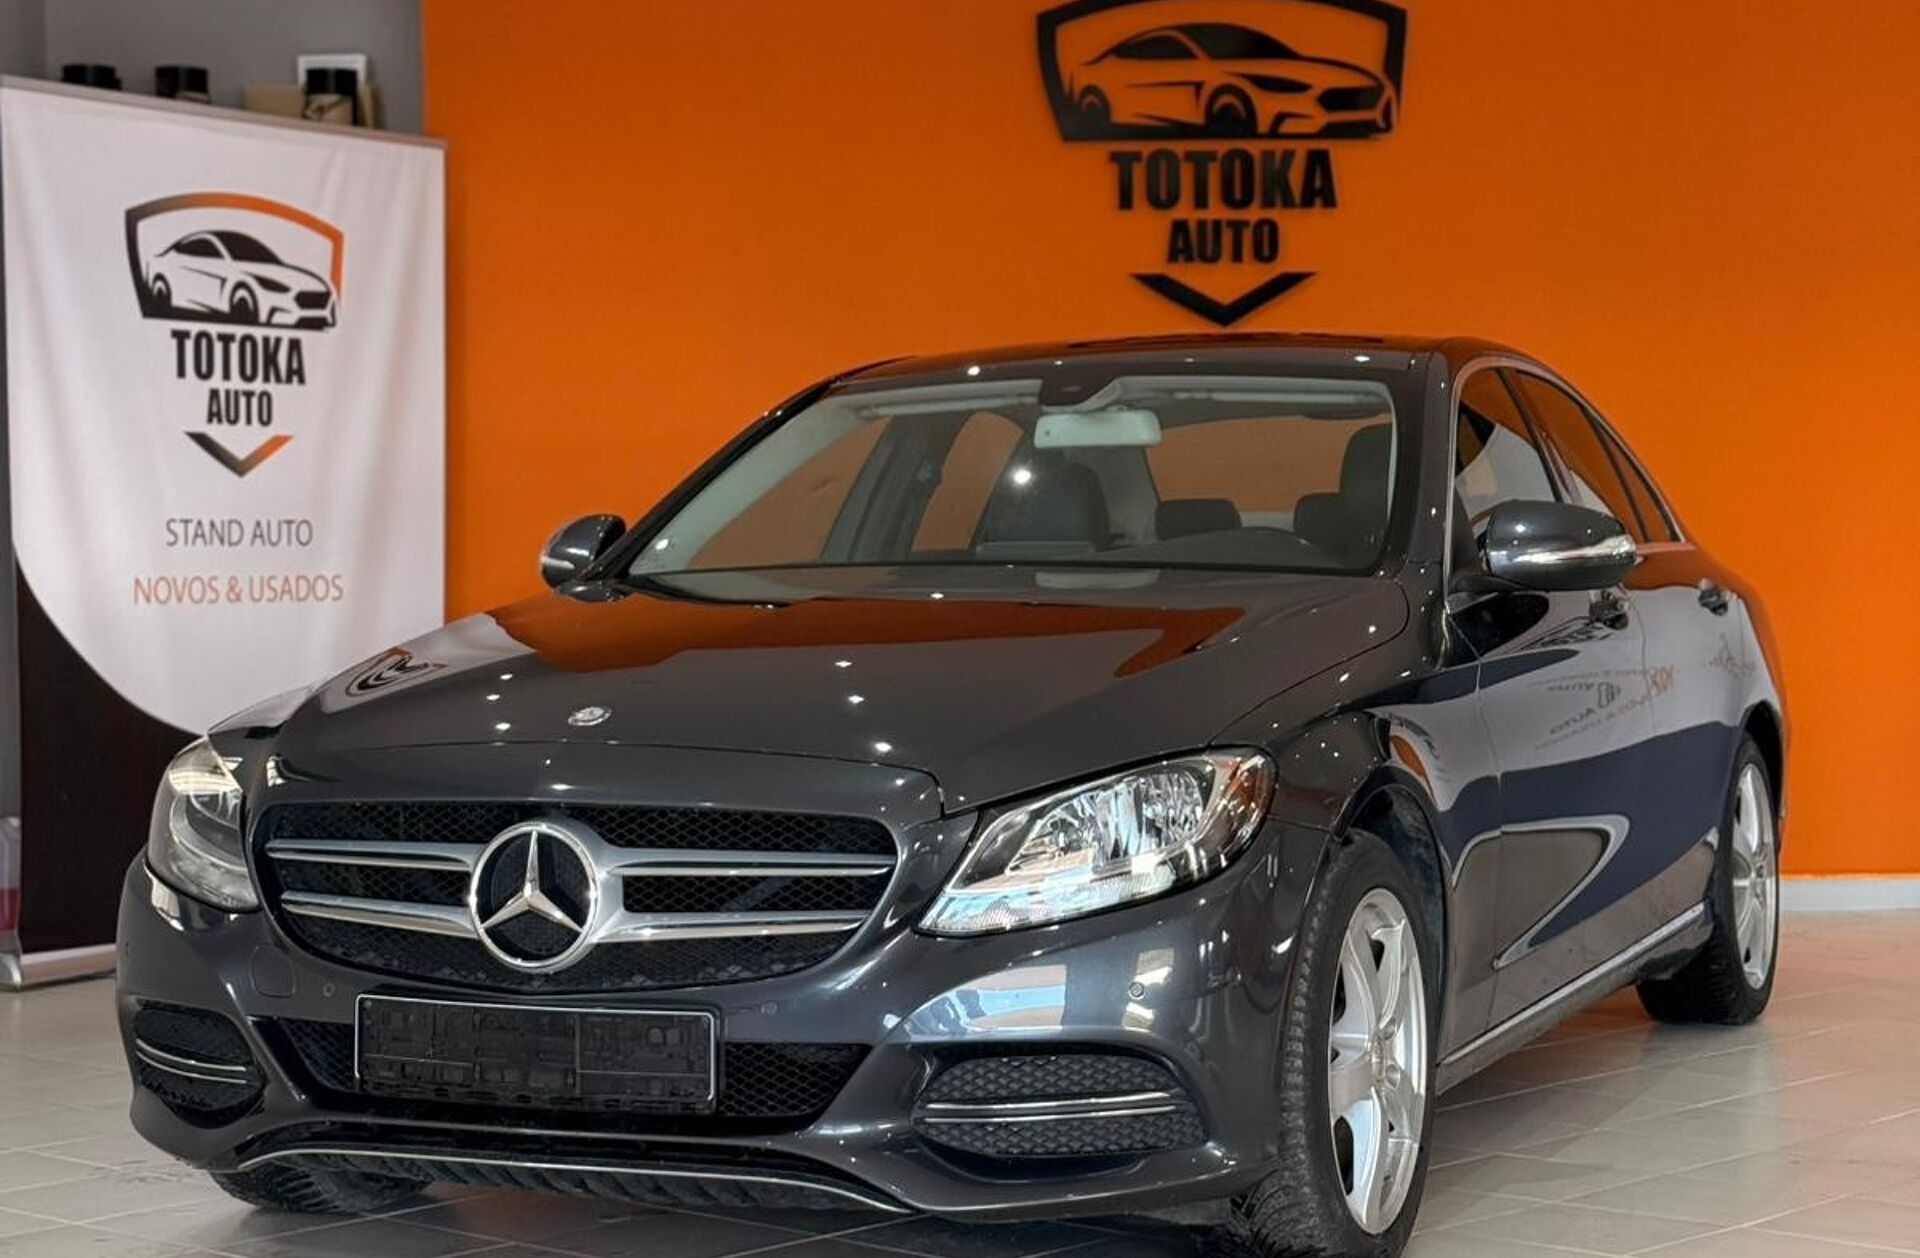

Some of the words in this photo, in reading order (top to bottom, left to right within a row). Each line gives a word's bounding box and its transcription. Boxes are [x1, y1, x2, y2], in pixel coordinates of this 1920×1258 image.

[1109, 148, 1338, 211] TOTOKA
[1166, 217, 1281, 265] AUTO
[171, 328, 306, 386] TOTOKA
[206, 388, 273, 427] AUTO
[165, 517, 245, 548] STAND
[251, 518, 314, 548] AUTO
[133, 575, 221, 606] NOVOS
[225, 575, 244, 605] &
[248, 573, 344, 604] USADOS
